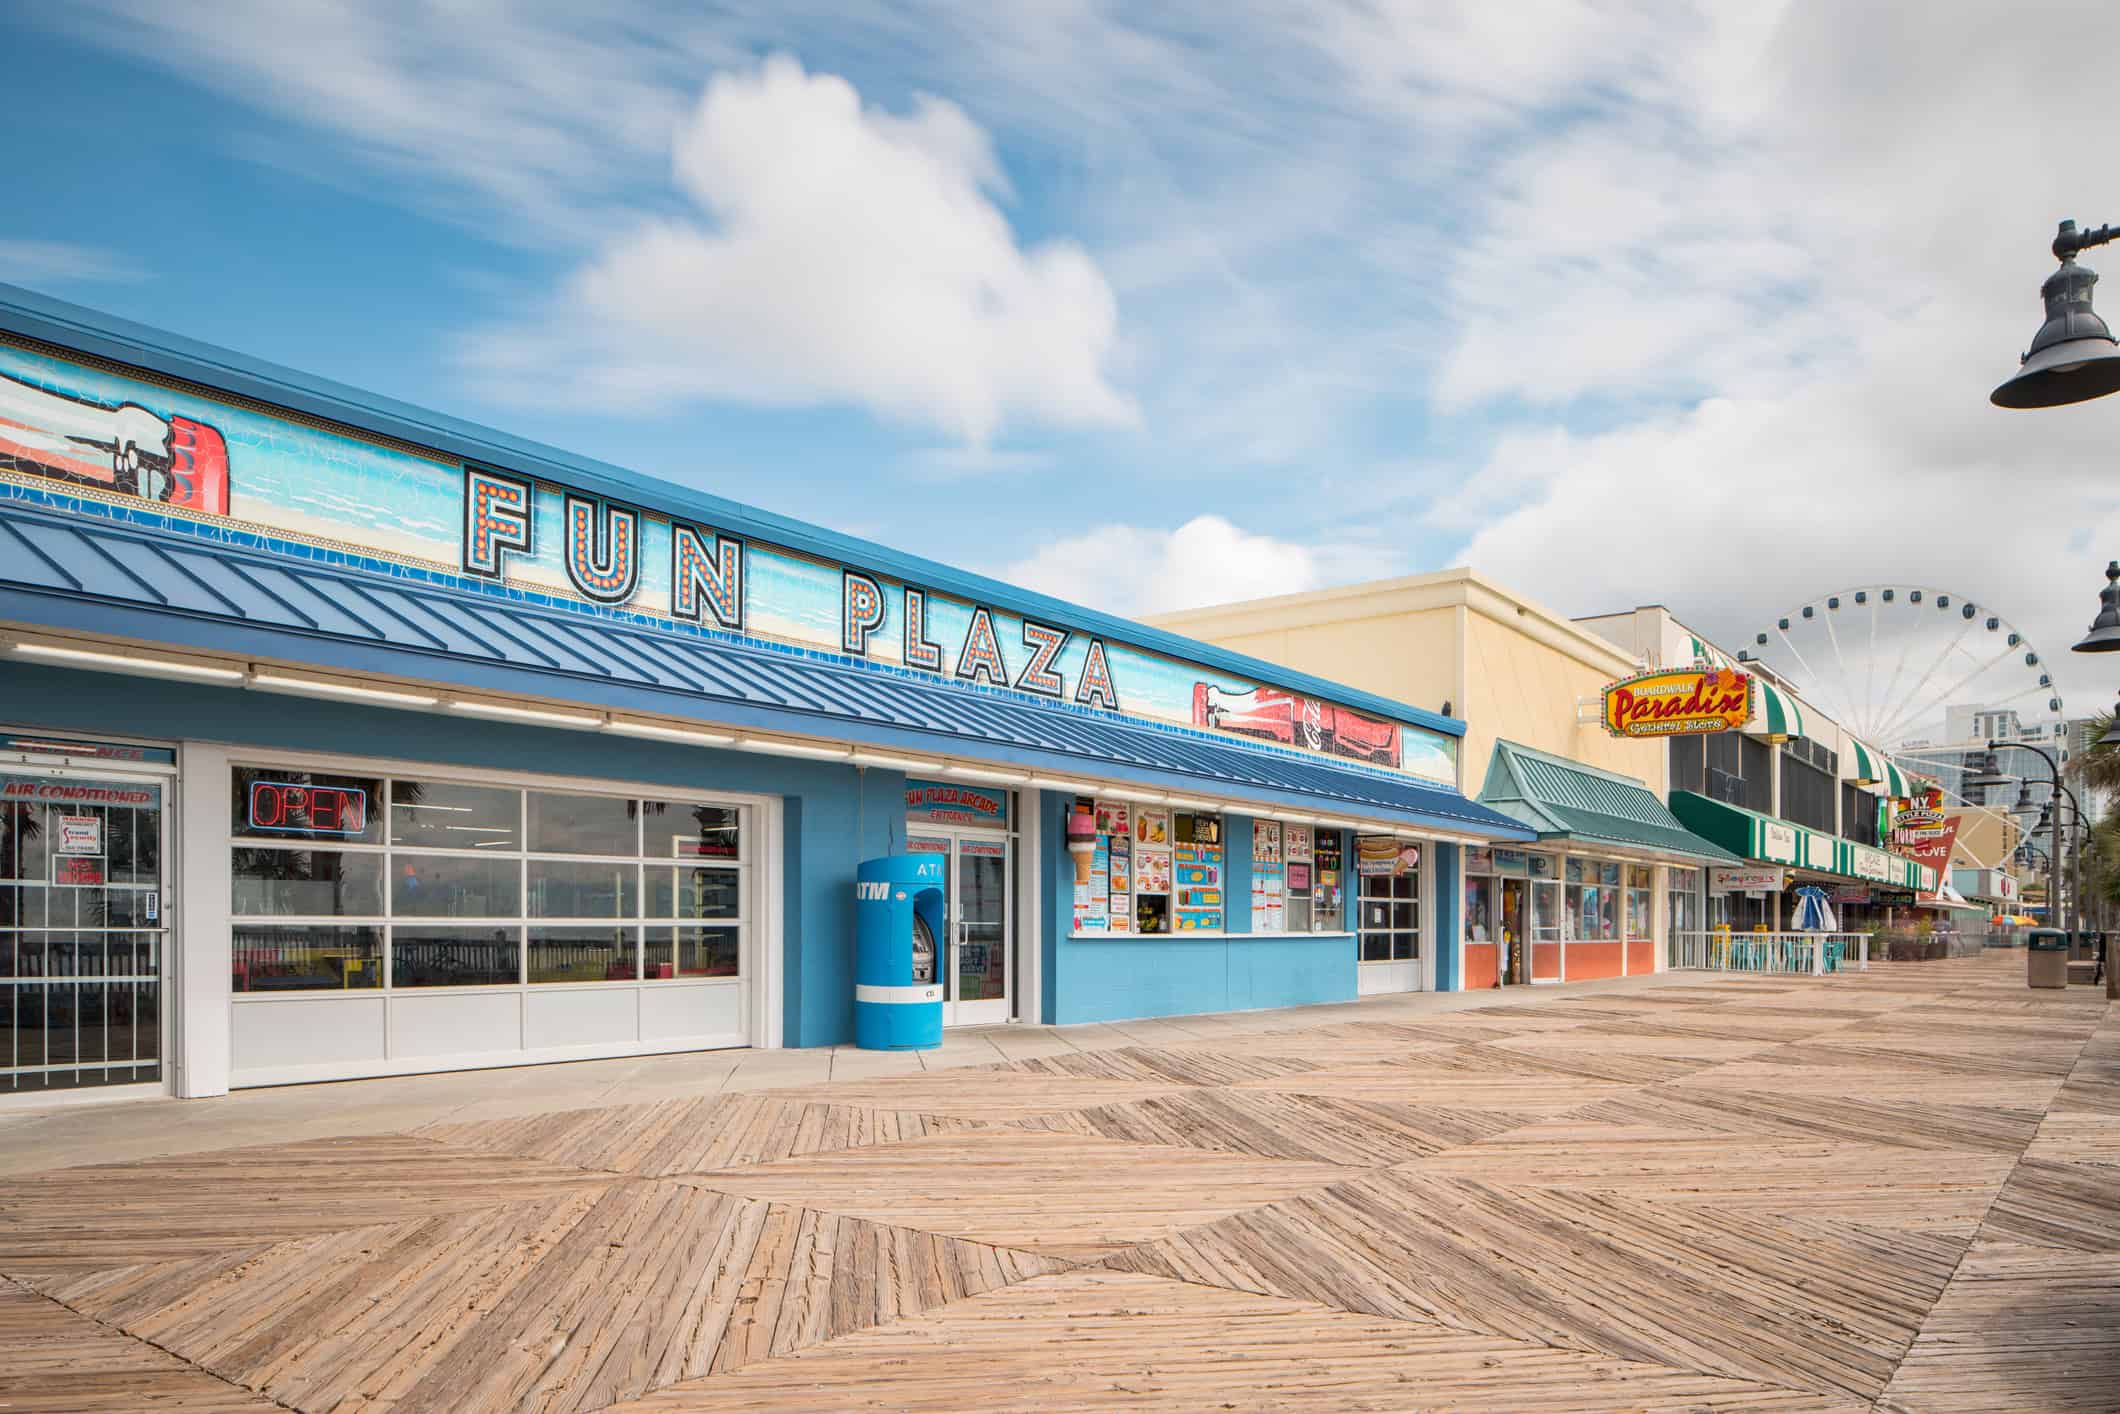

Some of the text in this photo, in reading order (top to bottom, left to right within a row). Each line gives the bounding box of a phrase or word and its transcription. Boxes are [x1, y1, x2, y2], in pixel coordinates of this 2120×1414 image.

[462, 465, 1118, 711] FUN PLAZA
[1634, 683, 1694, 696] BOARDWALK
[1615, 678, 1744, 728] Paradise
[1630, 720, 1721, 735] General Store
[4, 783, 151, 804] AIR CONDITIONED
[926, 787, 958, 803] PLAZA
[961, 791, 999, 816] ARCADE
[253, 785, 363, 831] OPEN
[1914, 846, 1947, 857] OVE
